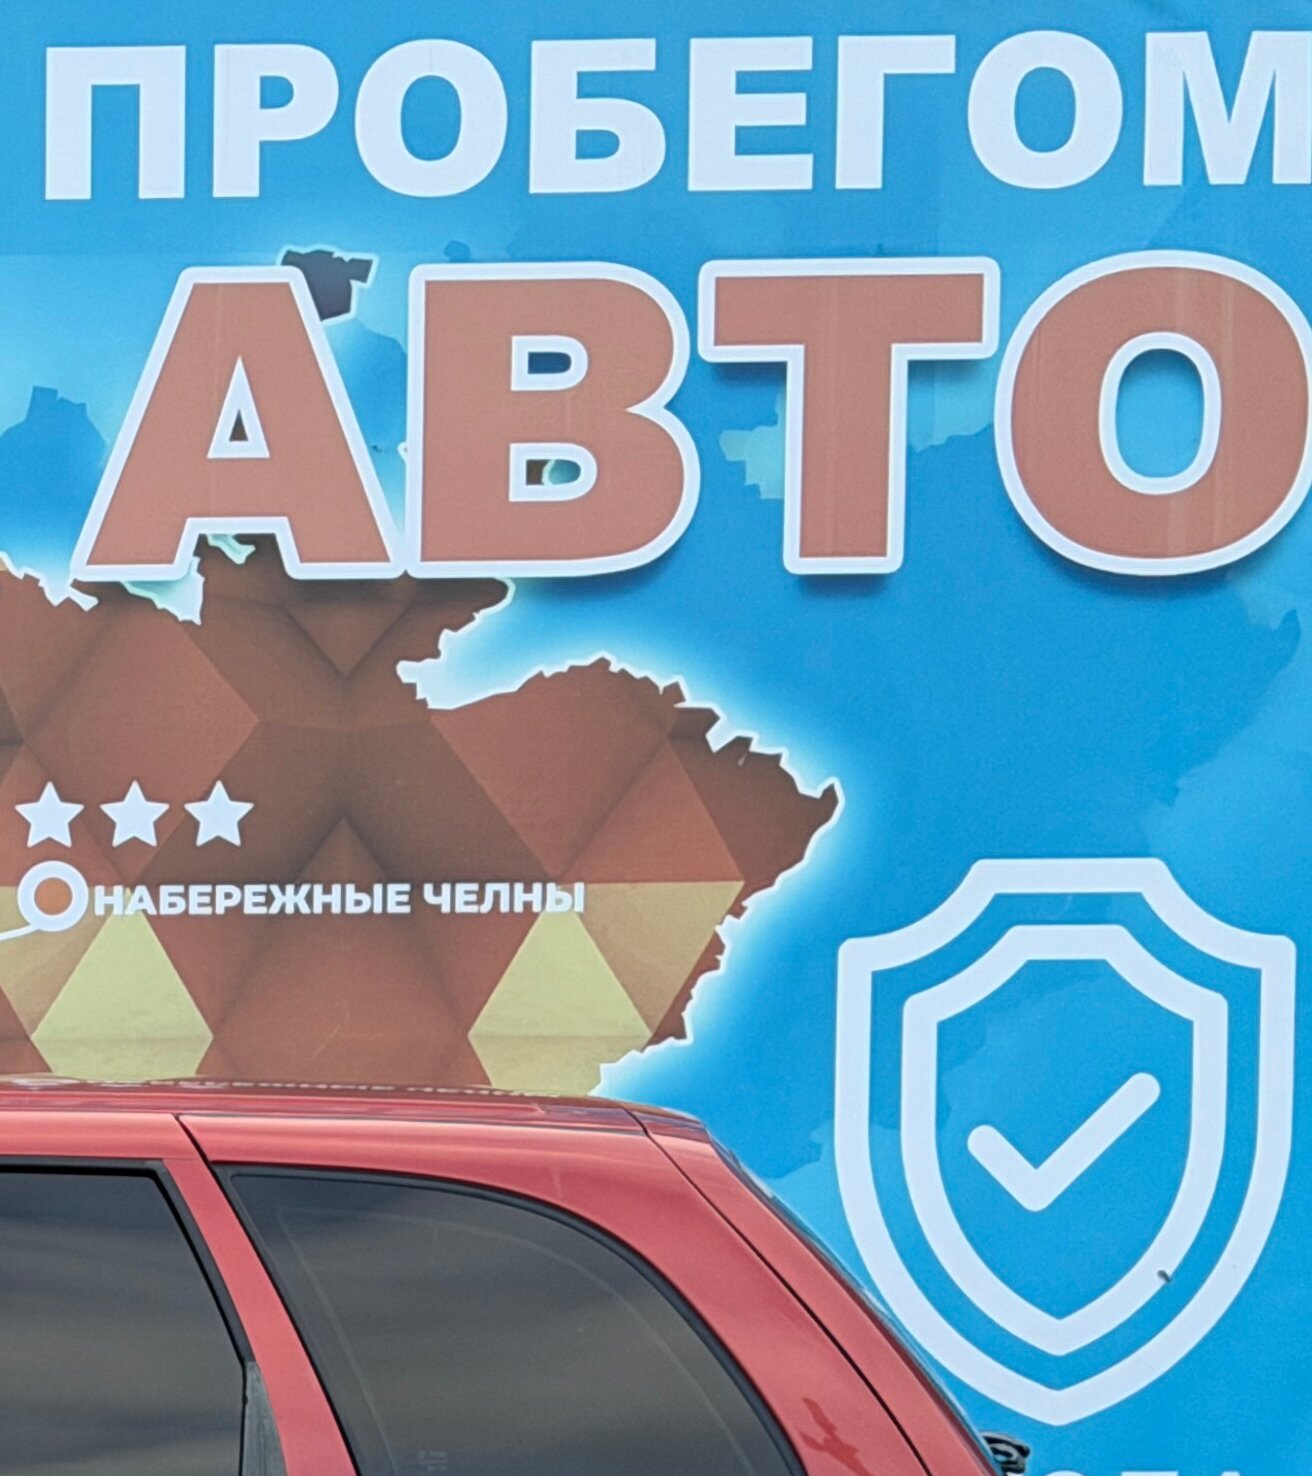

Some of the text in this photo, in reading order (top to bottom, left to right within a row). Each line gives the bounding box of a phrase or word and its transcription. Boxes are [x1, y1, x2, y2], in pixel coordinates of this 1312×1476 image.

[45, 30, 1312, 201] ПРОБЕГОМ
[69, 250, 1312, 583] АВТО
[93, 881, 586, 915] НАБЕРЕЖНЫЕ ЧЕЛНЫ
